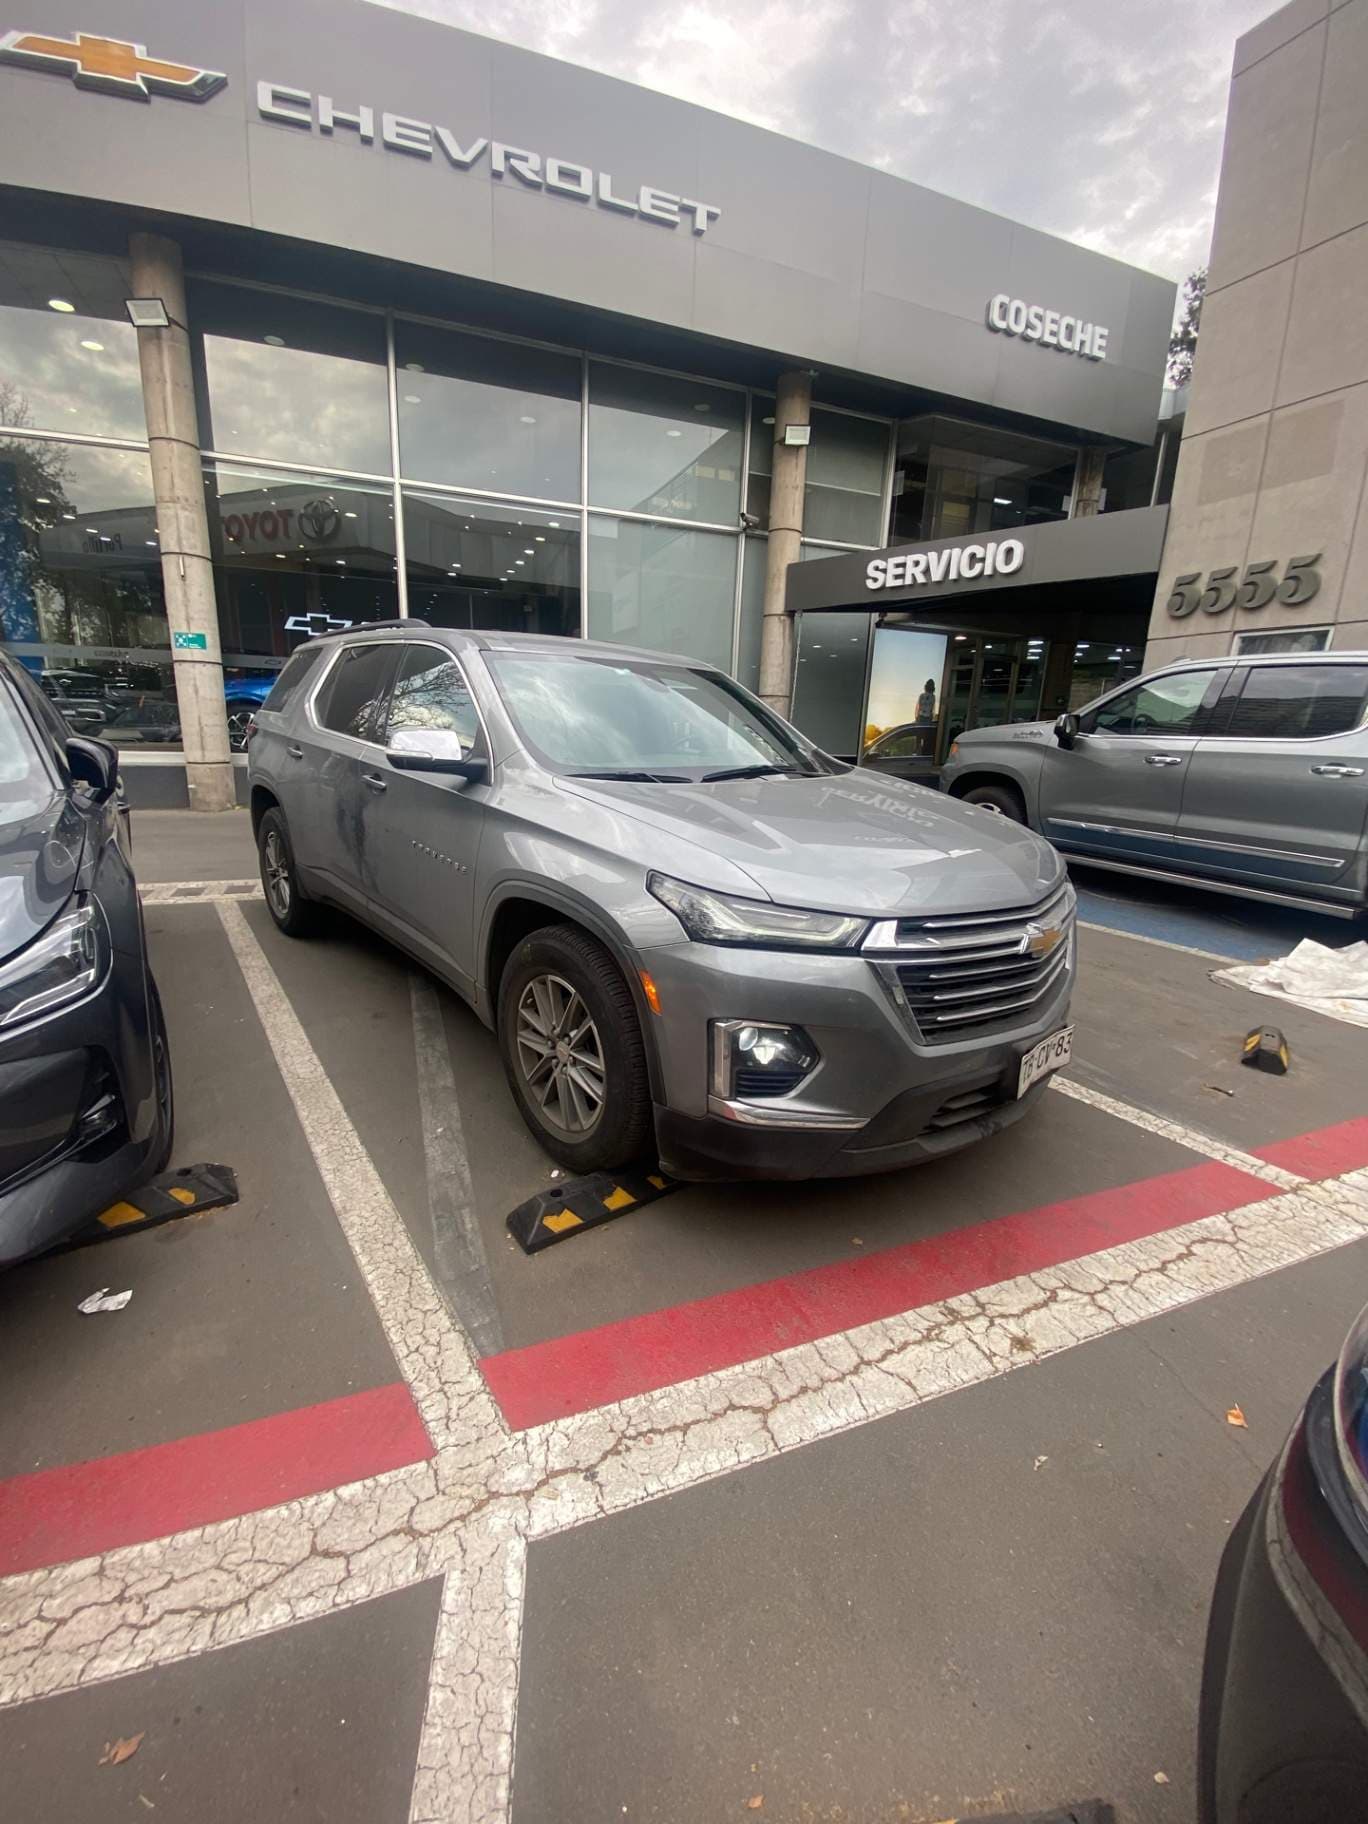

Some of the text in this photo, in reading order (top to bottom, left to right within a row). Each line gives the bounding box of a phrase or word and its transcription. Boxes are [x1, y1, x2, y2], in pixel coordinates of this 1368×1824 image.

[257, 81, 720, 235] CHEVROLET
[986, 293, 1109, 361] COSECHE
[865, 539, 1025, 590] SERVICIO
[1167, 553, 1323, 618] 5555
